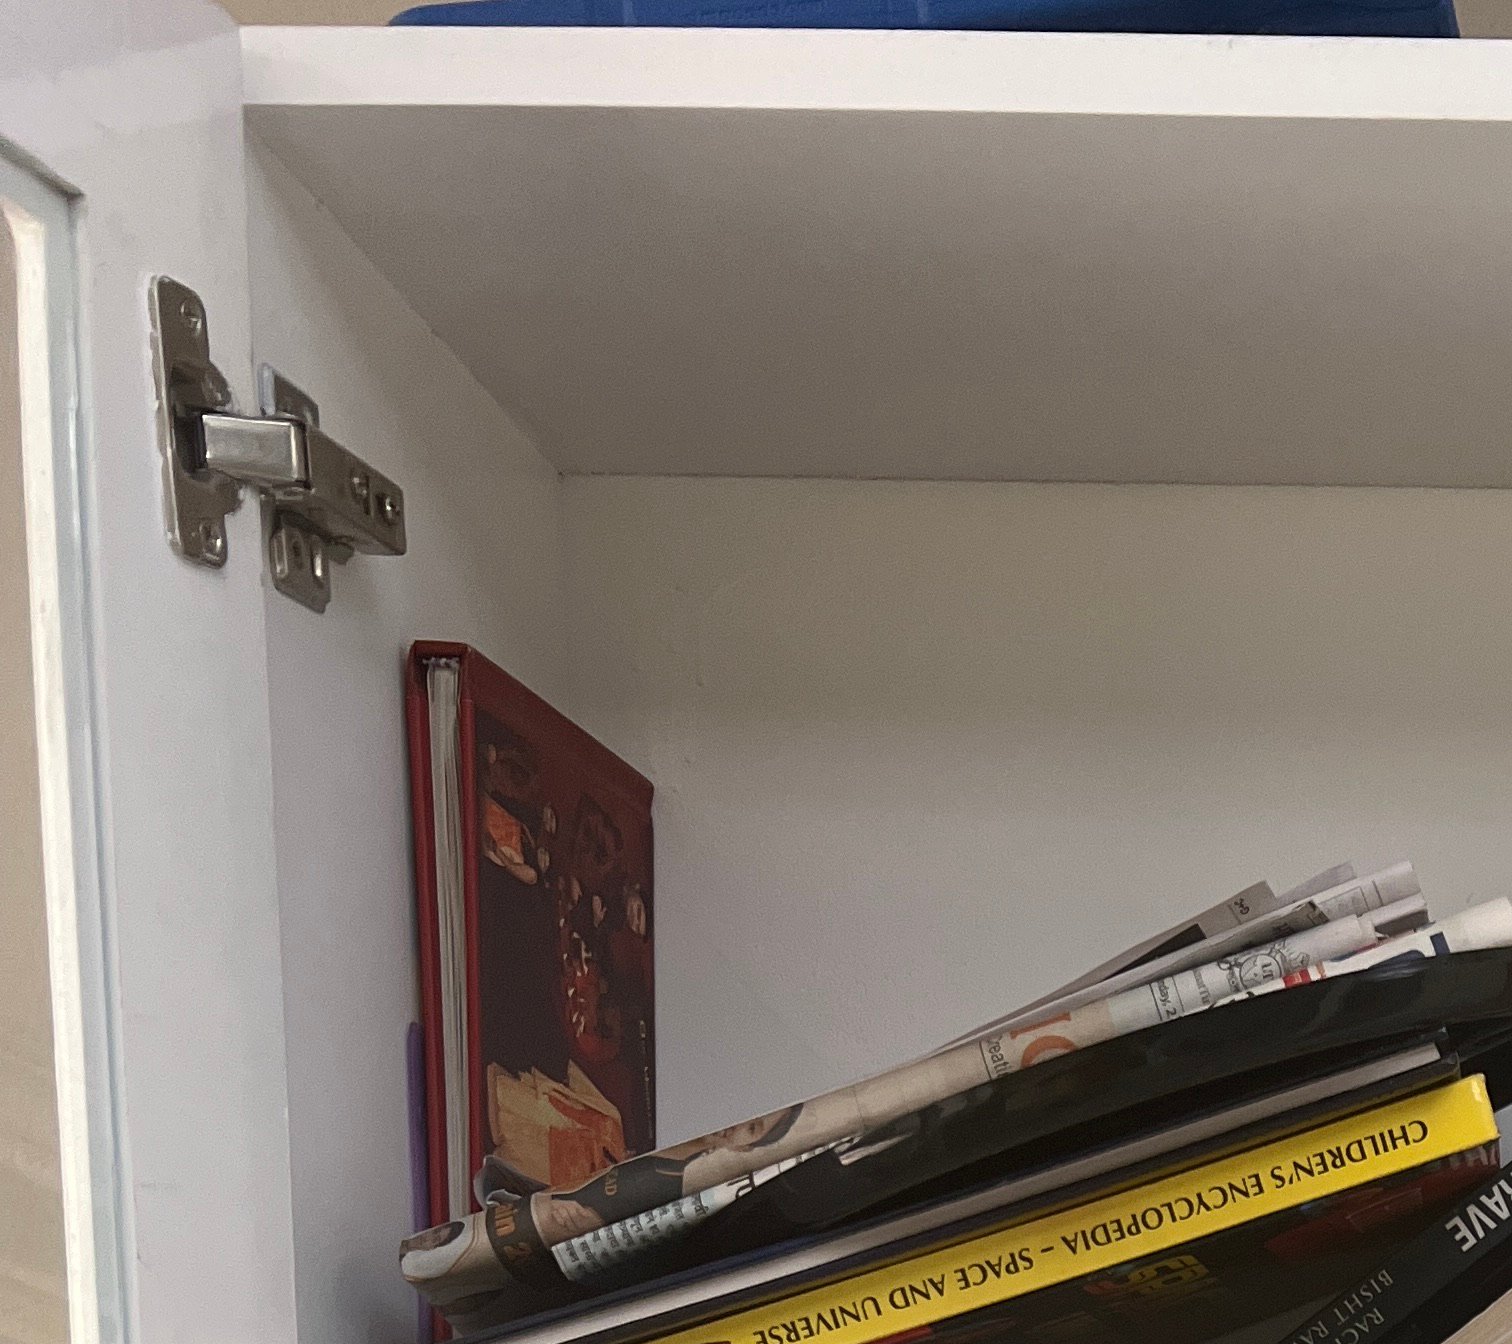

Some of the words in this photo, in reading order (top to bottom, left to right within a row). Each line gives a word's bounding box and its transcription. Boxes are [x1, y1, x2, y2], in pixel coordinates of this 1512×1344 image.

[1059, 1170, 1265, 1256] ENCYCLOPEDIA
[885, 1271, 950, 1312] AND
[953, 1244, 1035, 1291] SPACE
[1328, 1267, 1396, 1327] BISHT
